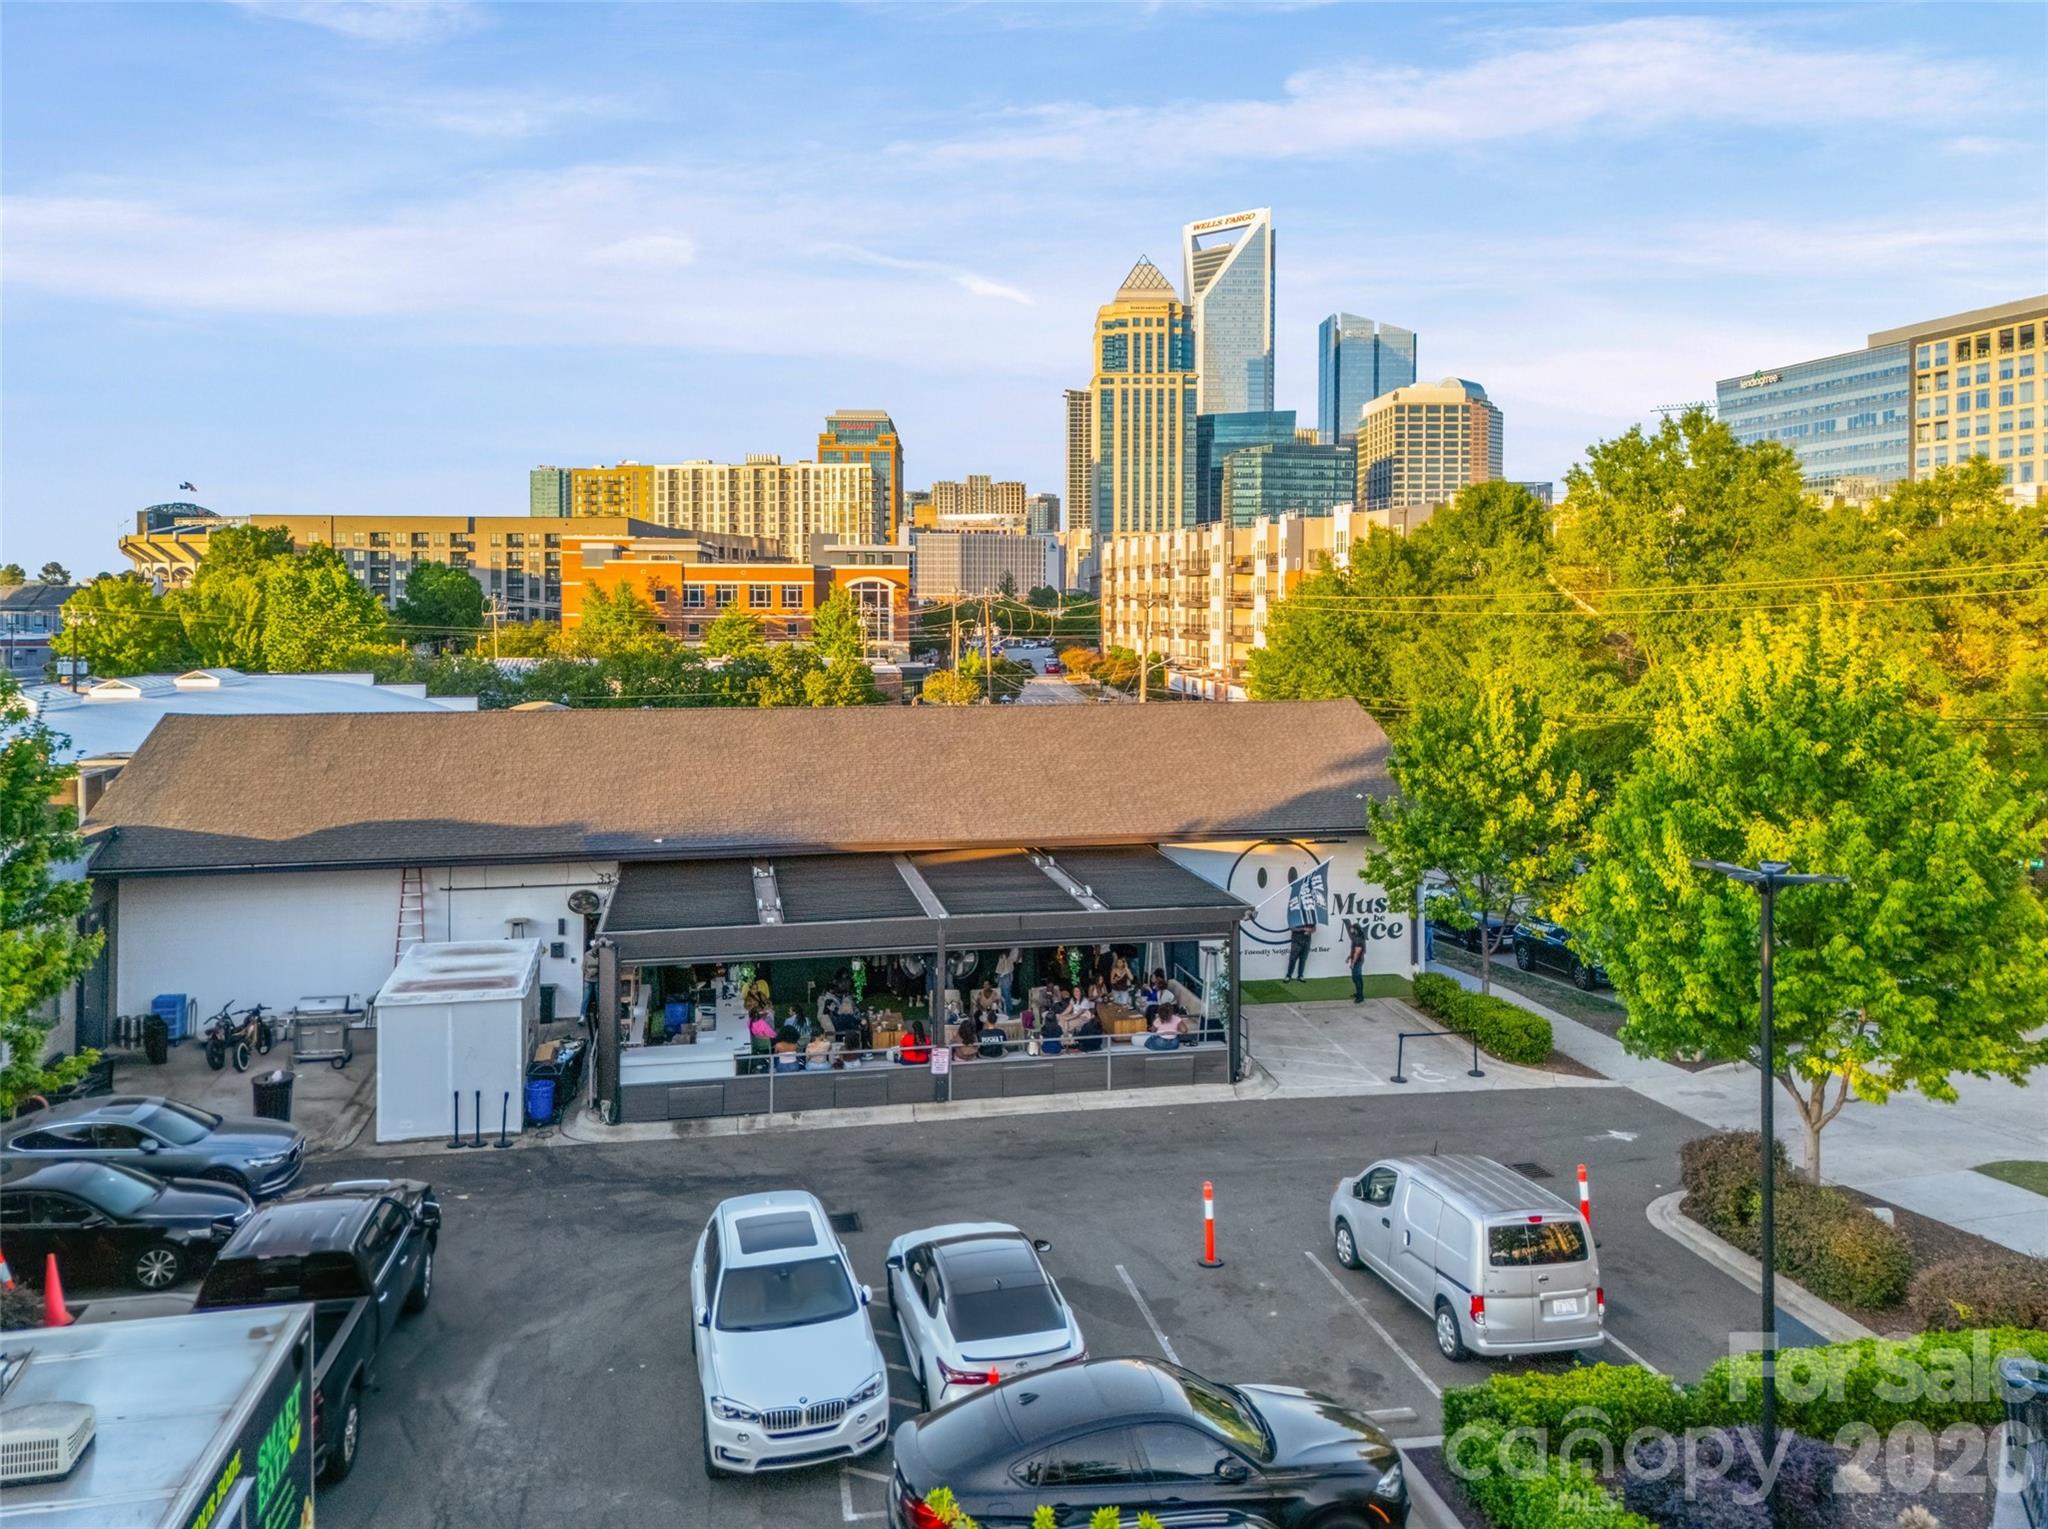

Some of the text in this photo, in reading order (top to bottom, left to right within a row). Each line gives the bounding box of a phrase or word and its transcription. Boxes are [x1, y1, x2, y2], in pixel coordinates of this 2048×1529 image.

[1193, 213, 1256, 230] WELLS FARGO
[1311, 874, 1325, 891] FLY
[1331, 893, 1388, 915] Mus
